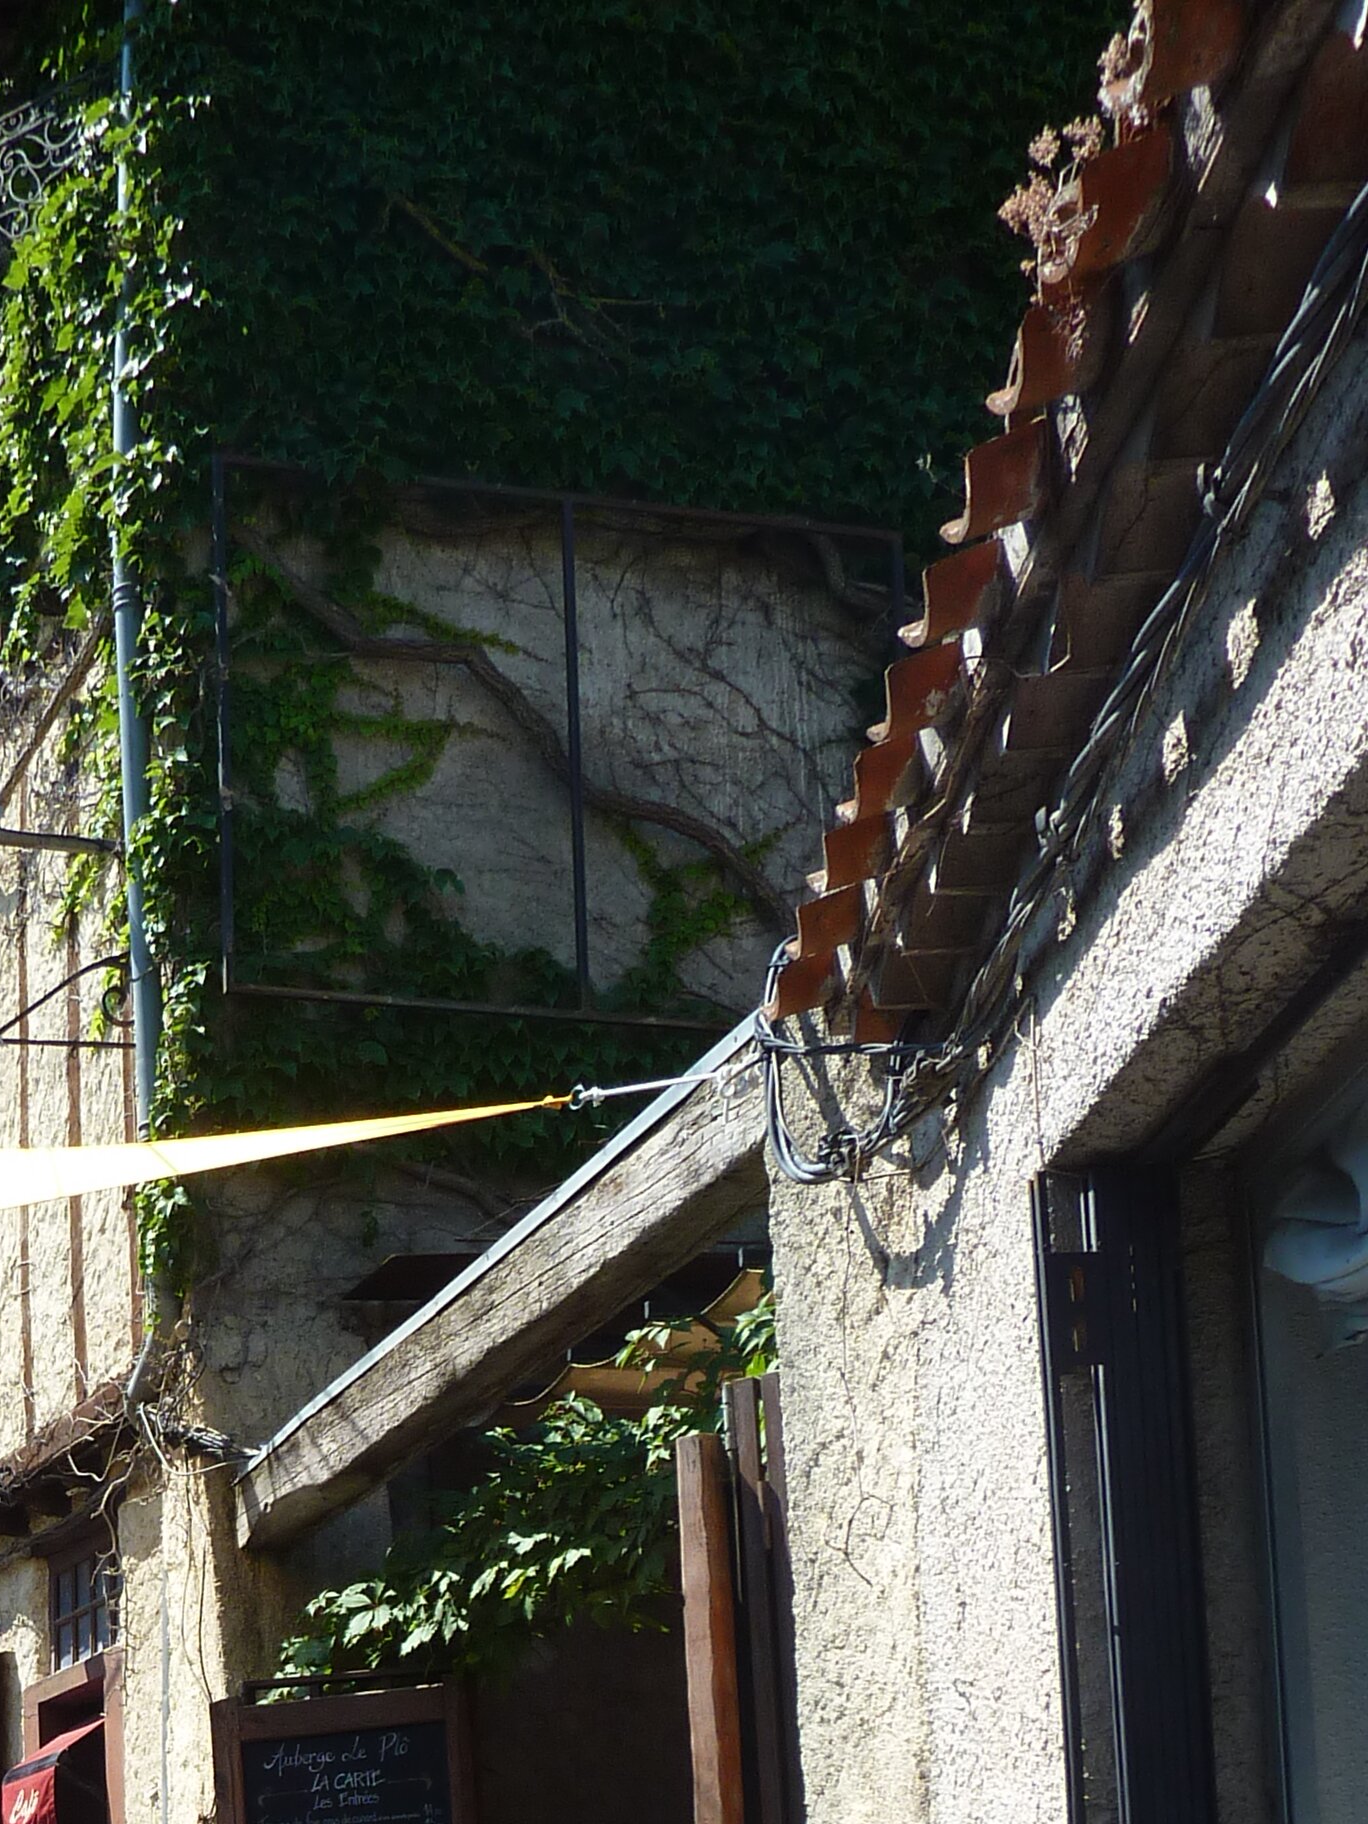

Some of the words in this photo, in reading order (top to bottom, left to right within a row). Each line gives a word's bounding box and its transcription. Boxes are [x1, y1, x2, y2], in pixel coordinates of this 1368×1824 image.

[264, 1743, 334, 1776] Auberge
[341, 1736, 368, 1761] Le
[310, 1773, 329, 1793] LA
[333, 1769, 386, 1790] CARTE
[8, 1788, 40, 1824] Café
[313, 1795, 333, 1810] Les
